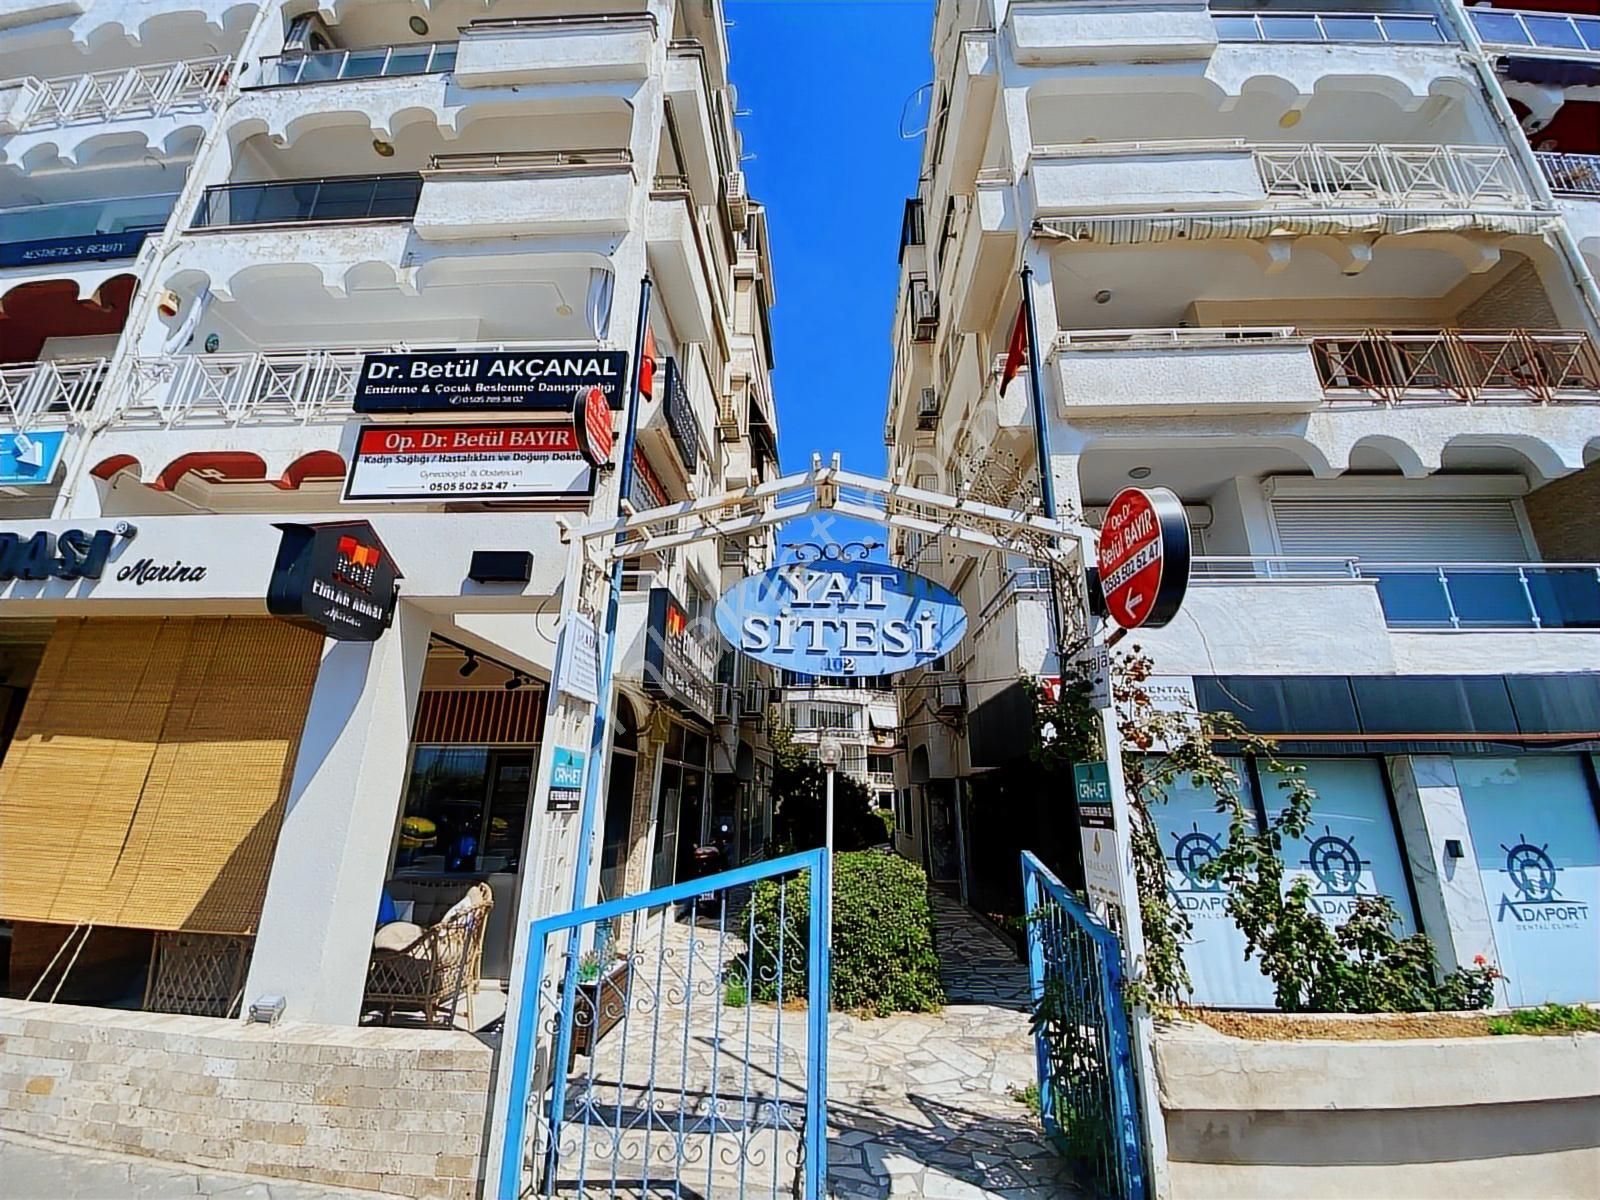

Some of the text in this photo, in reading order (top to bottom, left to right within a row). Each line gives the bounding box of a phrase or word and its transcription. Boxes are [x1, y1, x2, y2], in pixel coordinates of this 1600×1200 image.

[367, 359, 617, 382] Dr. Betül AKÇANAL
[364, 384, 418, 395] Emzirme
[421, 384, 431, 393] &
[434, 383, 472, 395] Çocuk
[475, 382, 535, 393] Beslenme
[385, 430, 569, 452] Op. Dr. Betül BAYIR
[395, 455, 430, 465] Sağlığı
[429, 481, 509, 492] 0505 502 52 47
[1124, 508, 1153, 550] BAYIR
[116, 558, 207, 586] Marina
[780, 571, 899, 612] YAT
[741, 609, 941, 656] SİTESİ
[1498, 891, 1589, 922] ADAPORT
